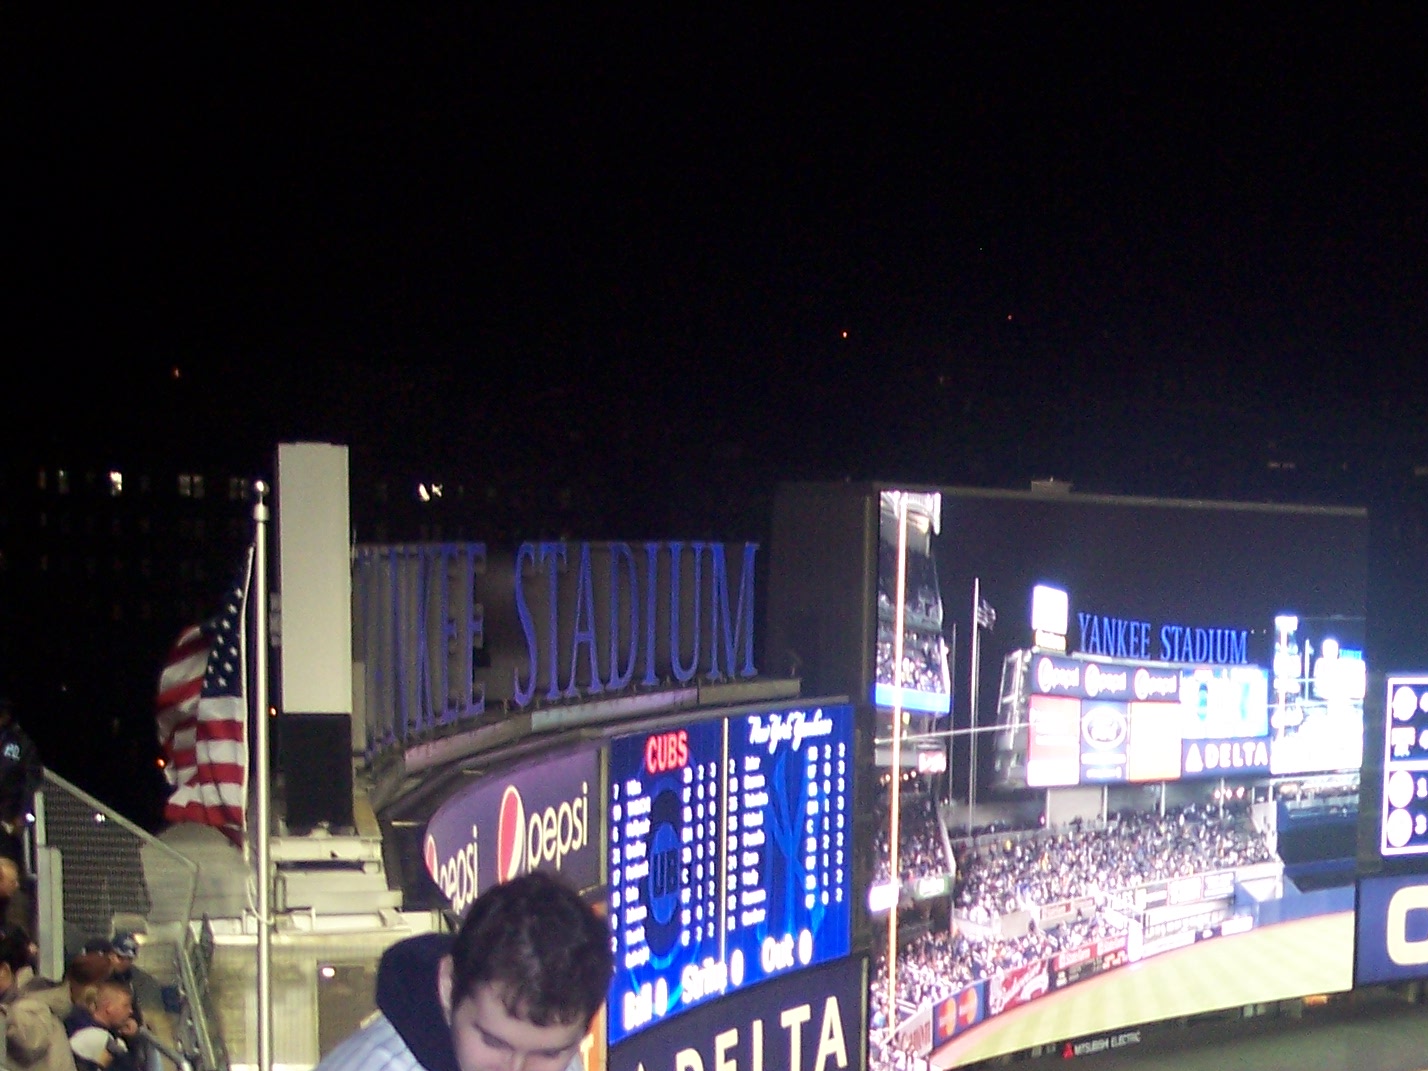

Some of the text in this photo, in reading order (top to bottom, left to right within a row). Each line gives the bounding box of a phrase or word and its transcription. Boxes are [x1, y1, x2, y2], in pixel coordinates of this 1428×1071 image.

[513, 540, 760, 706] STADIUM
[1078, 612, 1248, 664] YANKEE STADIUM
[646, 729, 689, 776] CUBS
[1205, 742, 1268, 770] DELTA
[528, 781, 589, 875] pepsi
